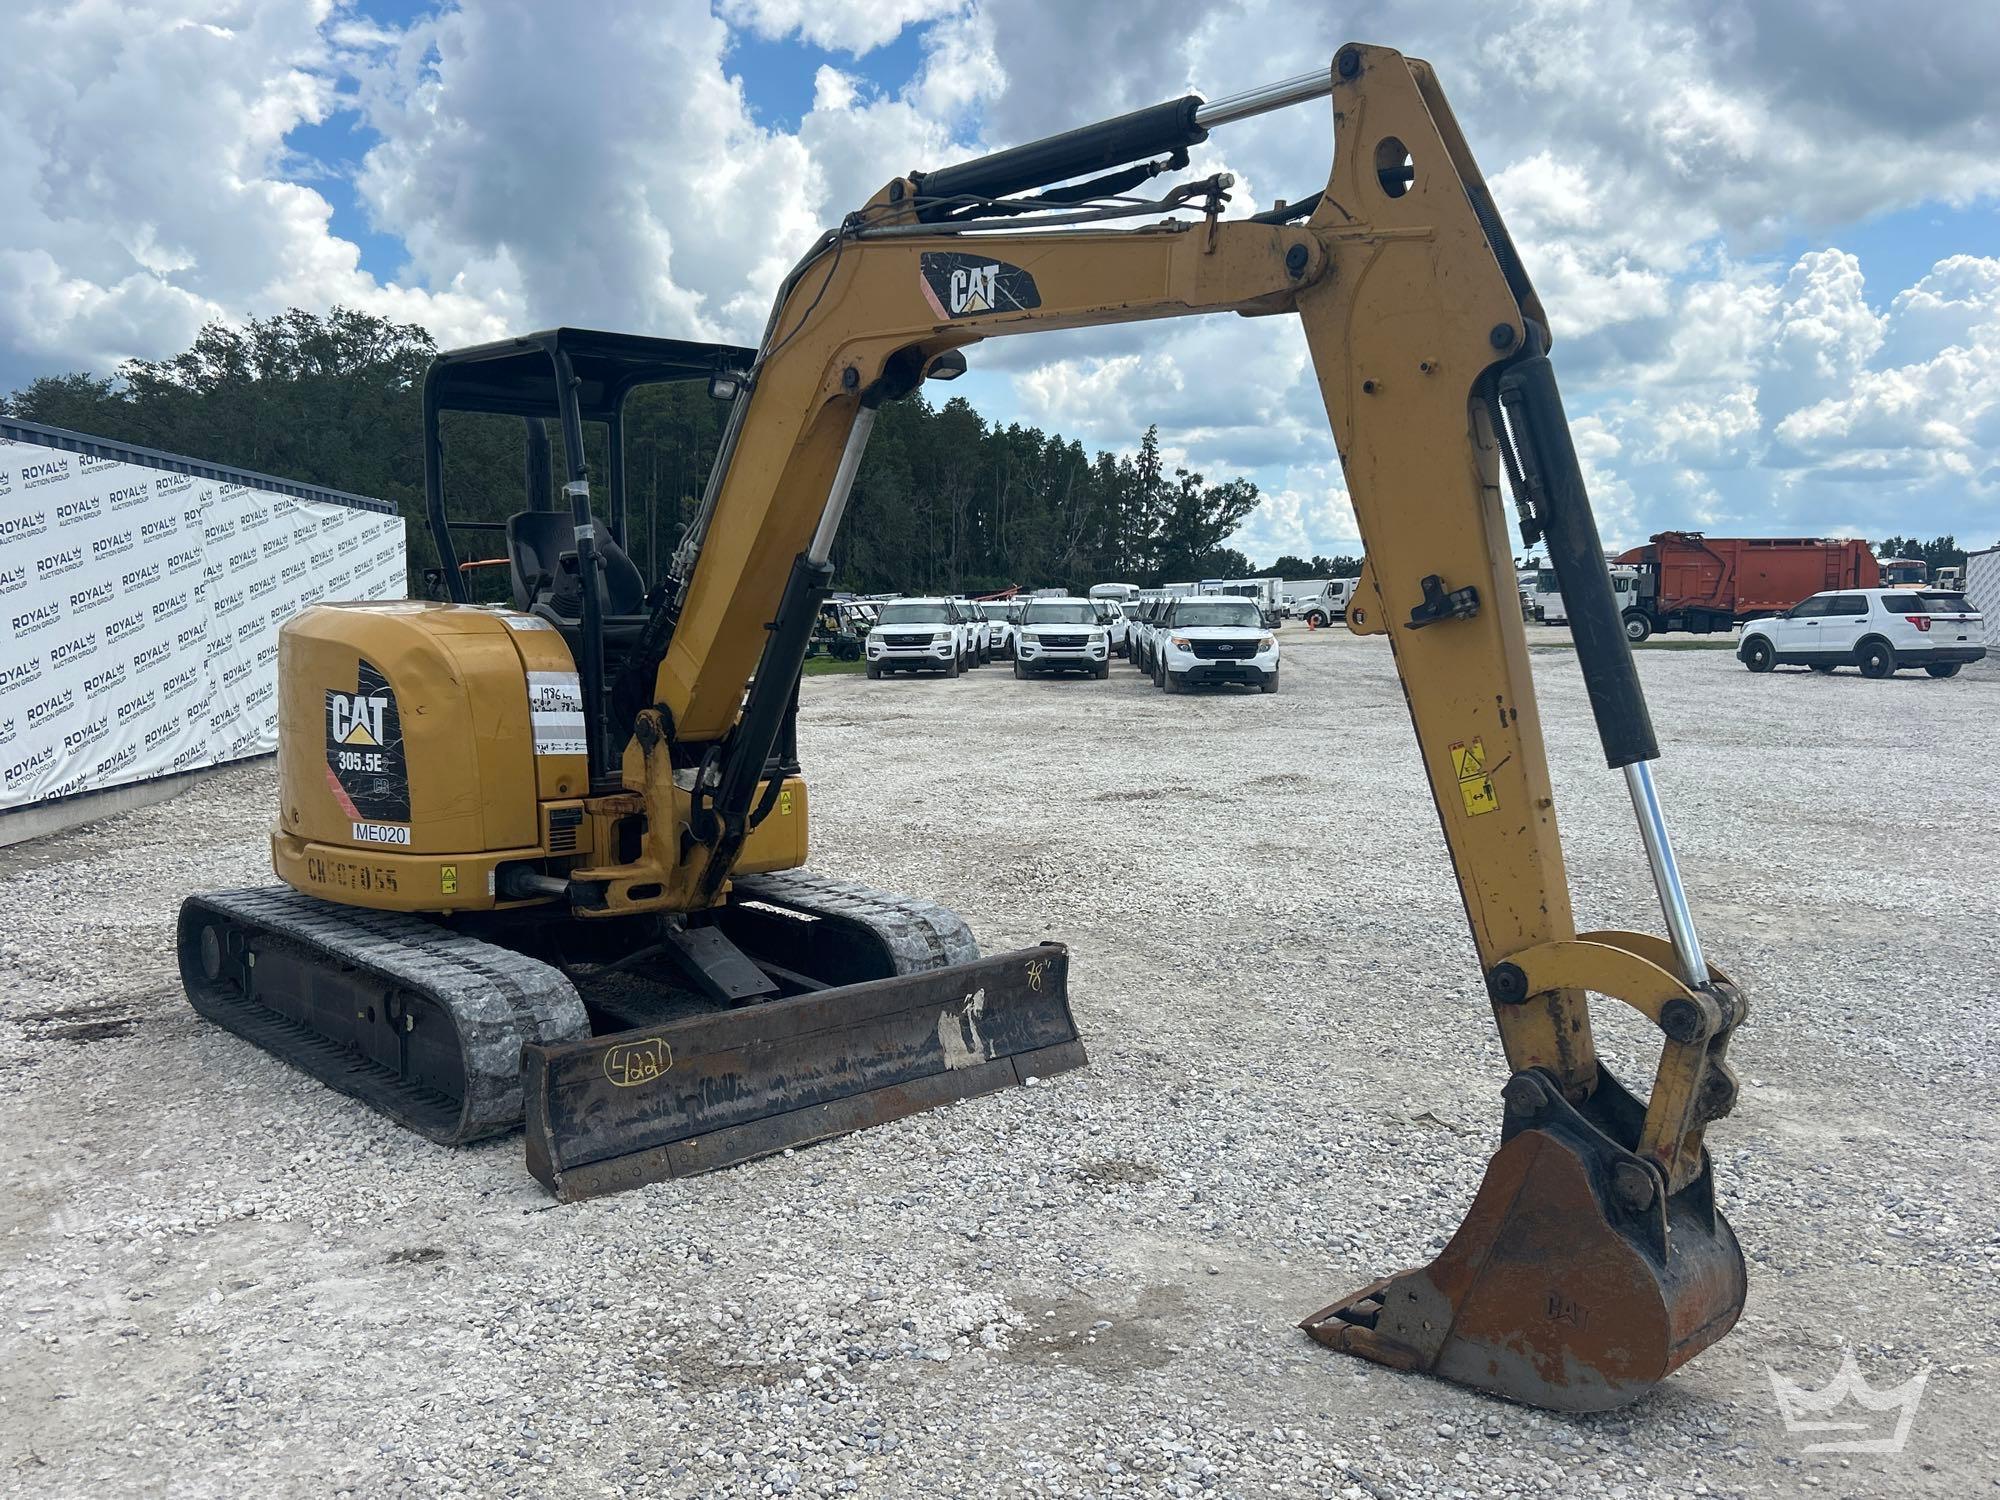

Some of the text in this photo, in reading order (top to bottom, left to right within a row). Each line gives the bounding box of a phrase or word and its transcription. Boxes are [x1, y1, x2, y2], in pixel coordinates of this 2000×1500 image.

[951, 265, 999, 313] CAT
[22, 462, 59, 480] ROYAL
[24, 478, 50, 490] AUCTION
[156, 474, 184, 490] ROYAL
[110, 486, 140, 503] ROYAL
[56, 500, 91, 518] ROYAL
[184, 508, 202, 522] ROY
[273, 499, 294, 513] ROYAL
[240, 510, 262, 525] ROYAL
[321, 514, 339, 528] ROYAL
[141, 519, 169, 536] ROYAL
[205, 522, 228, 539] ROYAL
[293, 525, 312, 539] ROYAL
[92, 534, 125, 553] ROYAL
[263, 537, 283, 553] ROYAL
[37, 551, 73, 572] ROYAL
[167, 551, 194, 569] ROYAL
[229, 550, 251, 567] ROYAL
[310, 551, 329, 564] ROYAL
[40, 567, 64, 581] AUCTION
[122, 567, 152, 586] ROYAL
[281, 563, 301, 579] ROYAL
[250, 578, 271, 594] ROYAL
[328, 574, 346, 588] ROYAL
[70, 586, 105, 607] ROYAL
[214, 595, 238, 612] ROYAL
[300, 588, 319, 601] ROYAL
[152, 596, 180, 616] ROYAL
[270, 604, 291, 619] ROYAL
[12, 606, 50, 630] ROYAL
[105, 616, 136, 637] ROYAL
[15, 623, 40, 639] AUCTION
[177, 624, 204, 644] ROYAL
[238, 620, 259, 637] ROYAL
[50, 637, 87, 661] ROYAL
[207, 638, 226, 654] OYAL
[257, 644, 278, 661] ROYAL
[53, 654, 77, 670] AUCTION
[133, 644, 163, 667] ROYAL
[0, 663, 31, 685] OYAL
[84, 668, 117, 692] ROYAL
[223, 663, 246, 682] ROYAL
[163, 671, 190, 693] ROYAL
[246, 687, 267, 705] ROYAL
[540, 687, 561, 701] 1986
[27, 695, 63, 721] ROYAL
[117, 695, 148, 719] ROYAL
[30, 712, 54, 730] AUCTION
[210, 708, 234, 727] ROYAL
[265, 713, 278, 728] ROY
[333, 694, 388, 746] CAT
[64, 722, 100, 748] ROYAL
[144, 721, 173, 746] ROYAL
[97, 749, 129, 775] ROYAL
[173, 744, 200, 768] ROYAL
[4, 752, 44, 783] ROYAL
[7, 772, 37, 791] AUCTION
[356, 824, 406, 844] ME020
